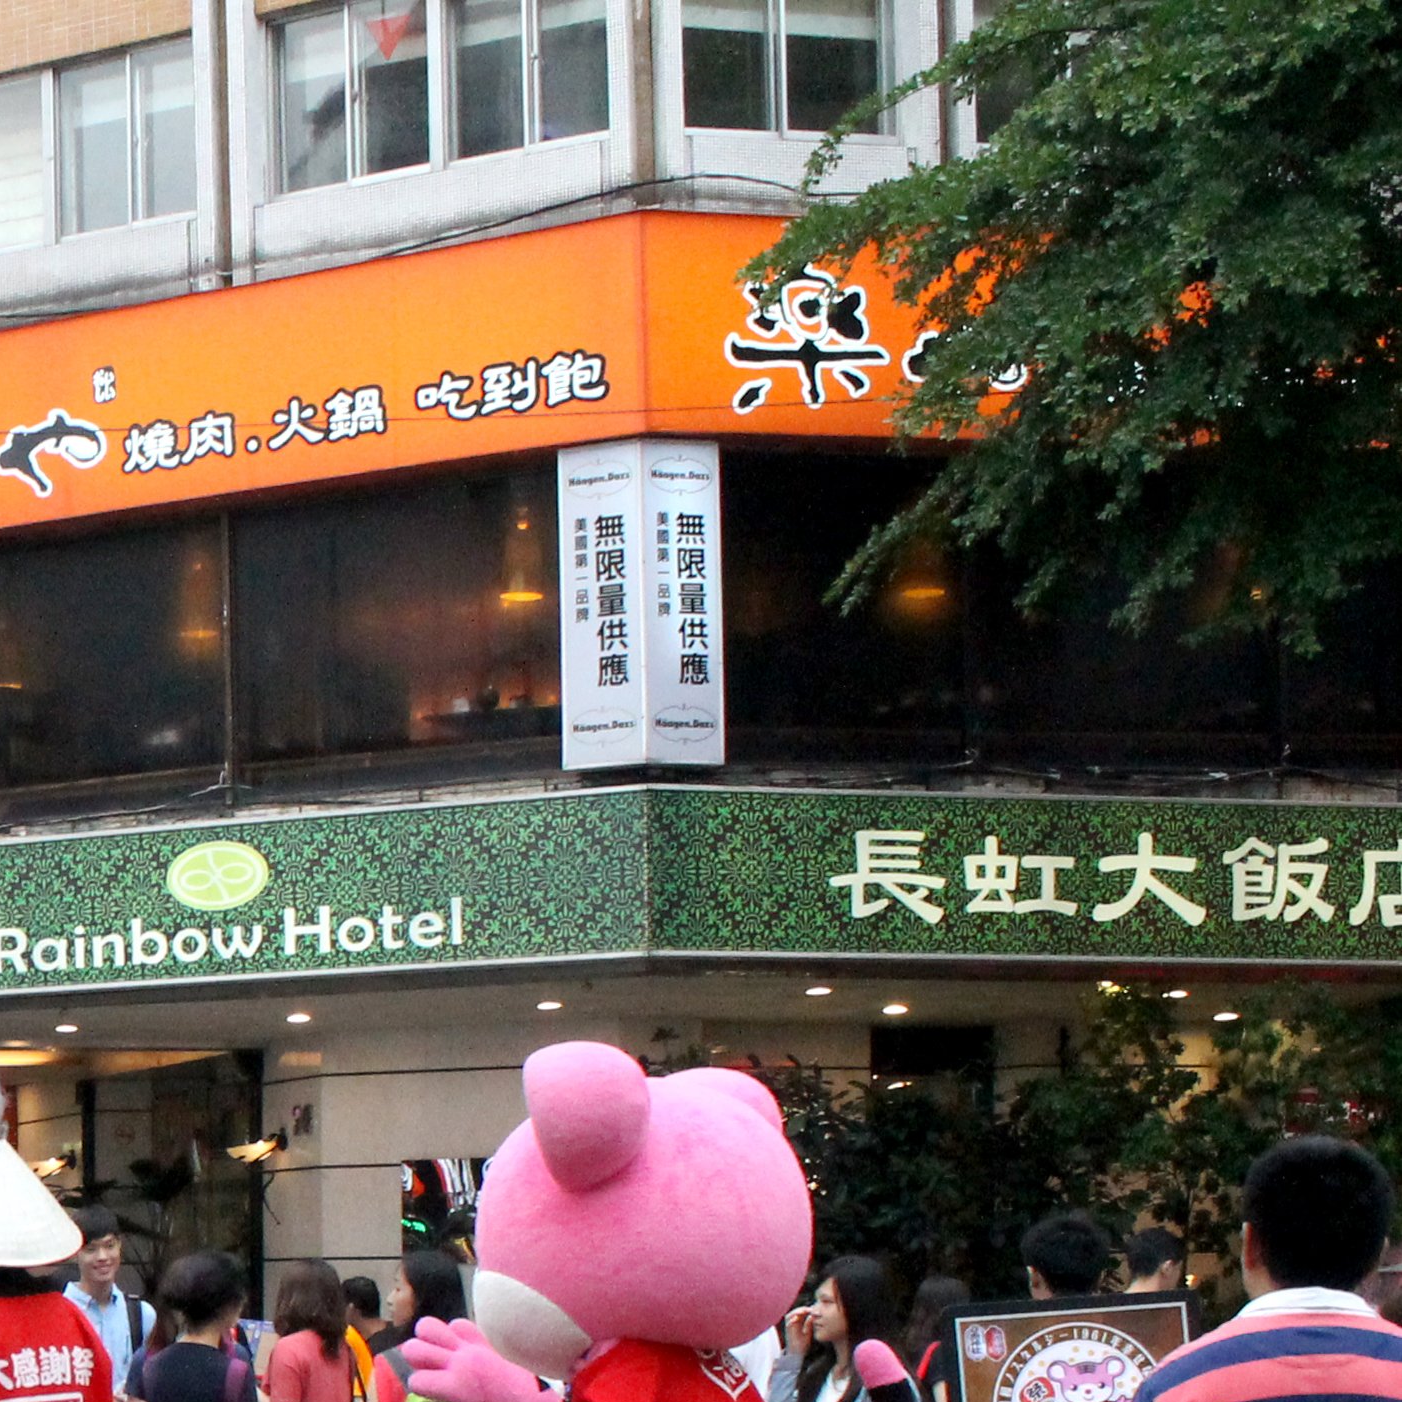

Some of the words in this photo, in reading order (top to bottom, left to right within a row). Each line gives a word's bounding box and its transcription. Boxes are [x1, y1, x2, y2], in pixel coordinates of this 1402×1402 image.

[416, 349, 608, 421] 吃到飽
[574, 518, 589, 624] 美國第一品牌
[594, 514, 629, 687] 無限量供應
[657, 511, 671, 617] 美國第一品牌
[676, 512, 710, 685] 無限量供應
[283, 896, 463, 956] Hotel
